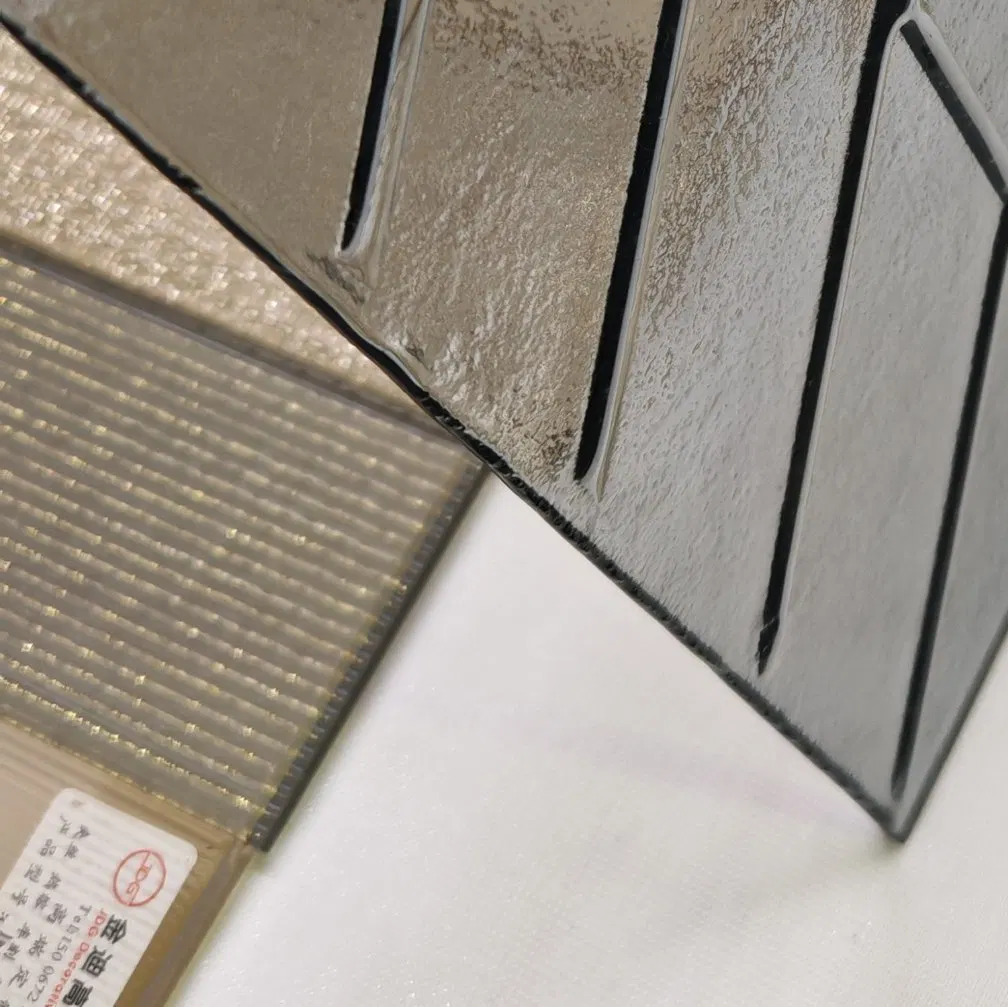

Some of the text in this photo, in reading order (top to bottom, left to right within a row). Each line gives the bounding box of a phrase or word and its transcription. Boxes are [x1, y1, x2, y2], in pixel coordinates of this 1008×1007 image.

[87, 907, 108, 938] JDG
[62, 913, 128, 1007] 金迪高
[26, 964, 56, 1004] 0672
